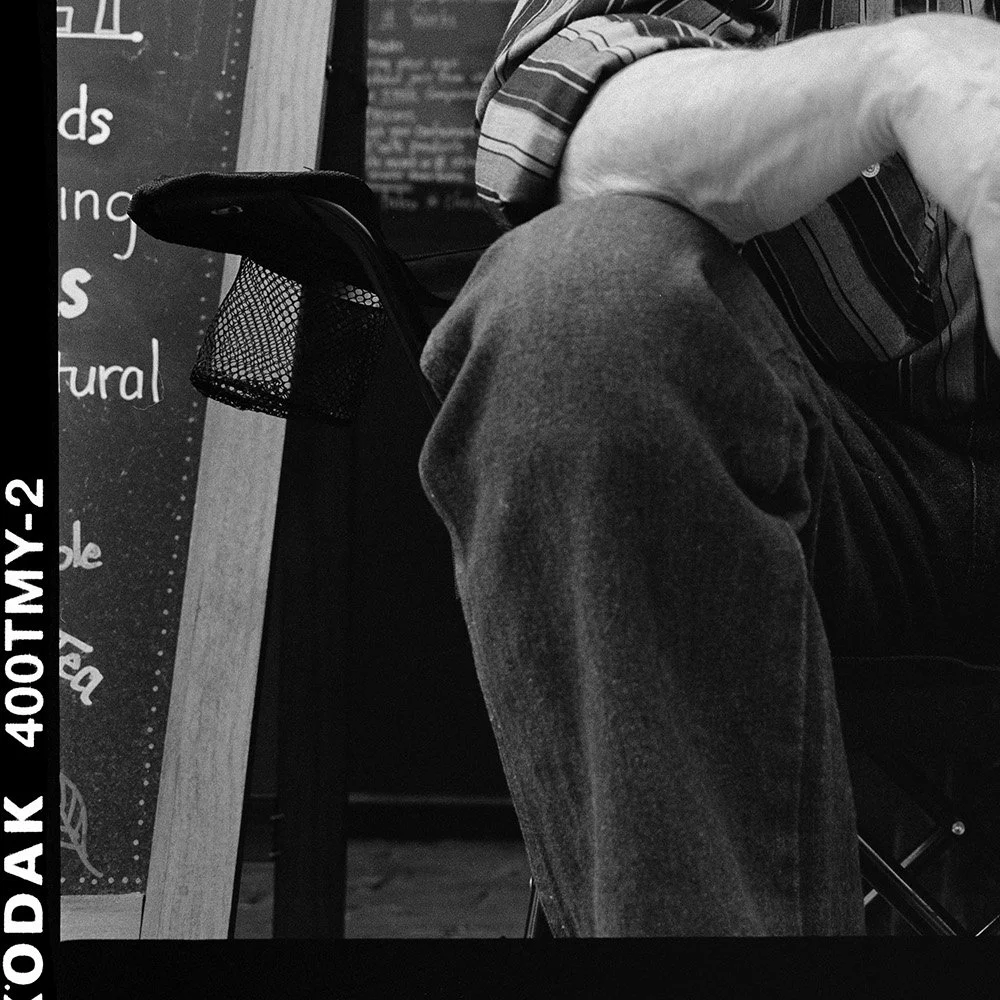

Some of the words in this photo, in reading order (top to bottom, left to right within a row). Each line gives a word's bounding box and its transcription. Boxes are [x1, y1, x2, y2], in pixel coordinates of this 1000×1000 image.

[58, 83, 113, 145] ds
[5, 479, 44, 747] 400TMY-2
[3, 796, 43, 1000] ODAK
